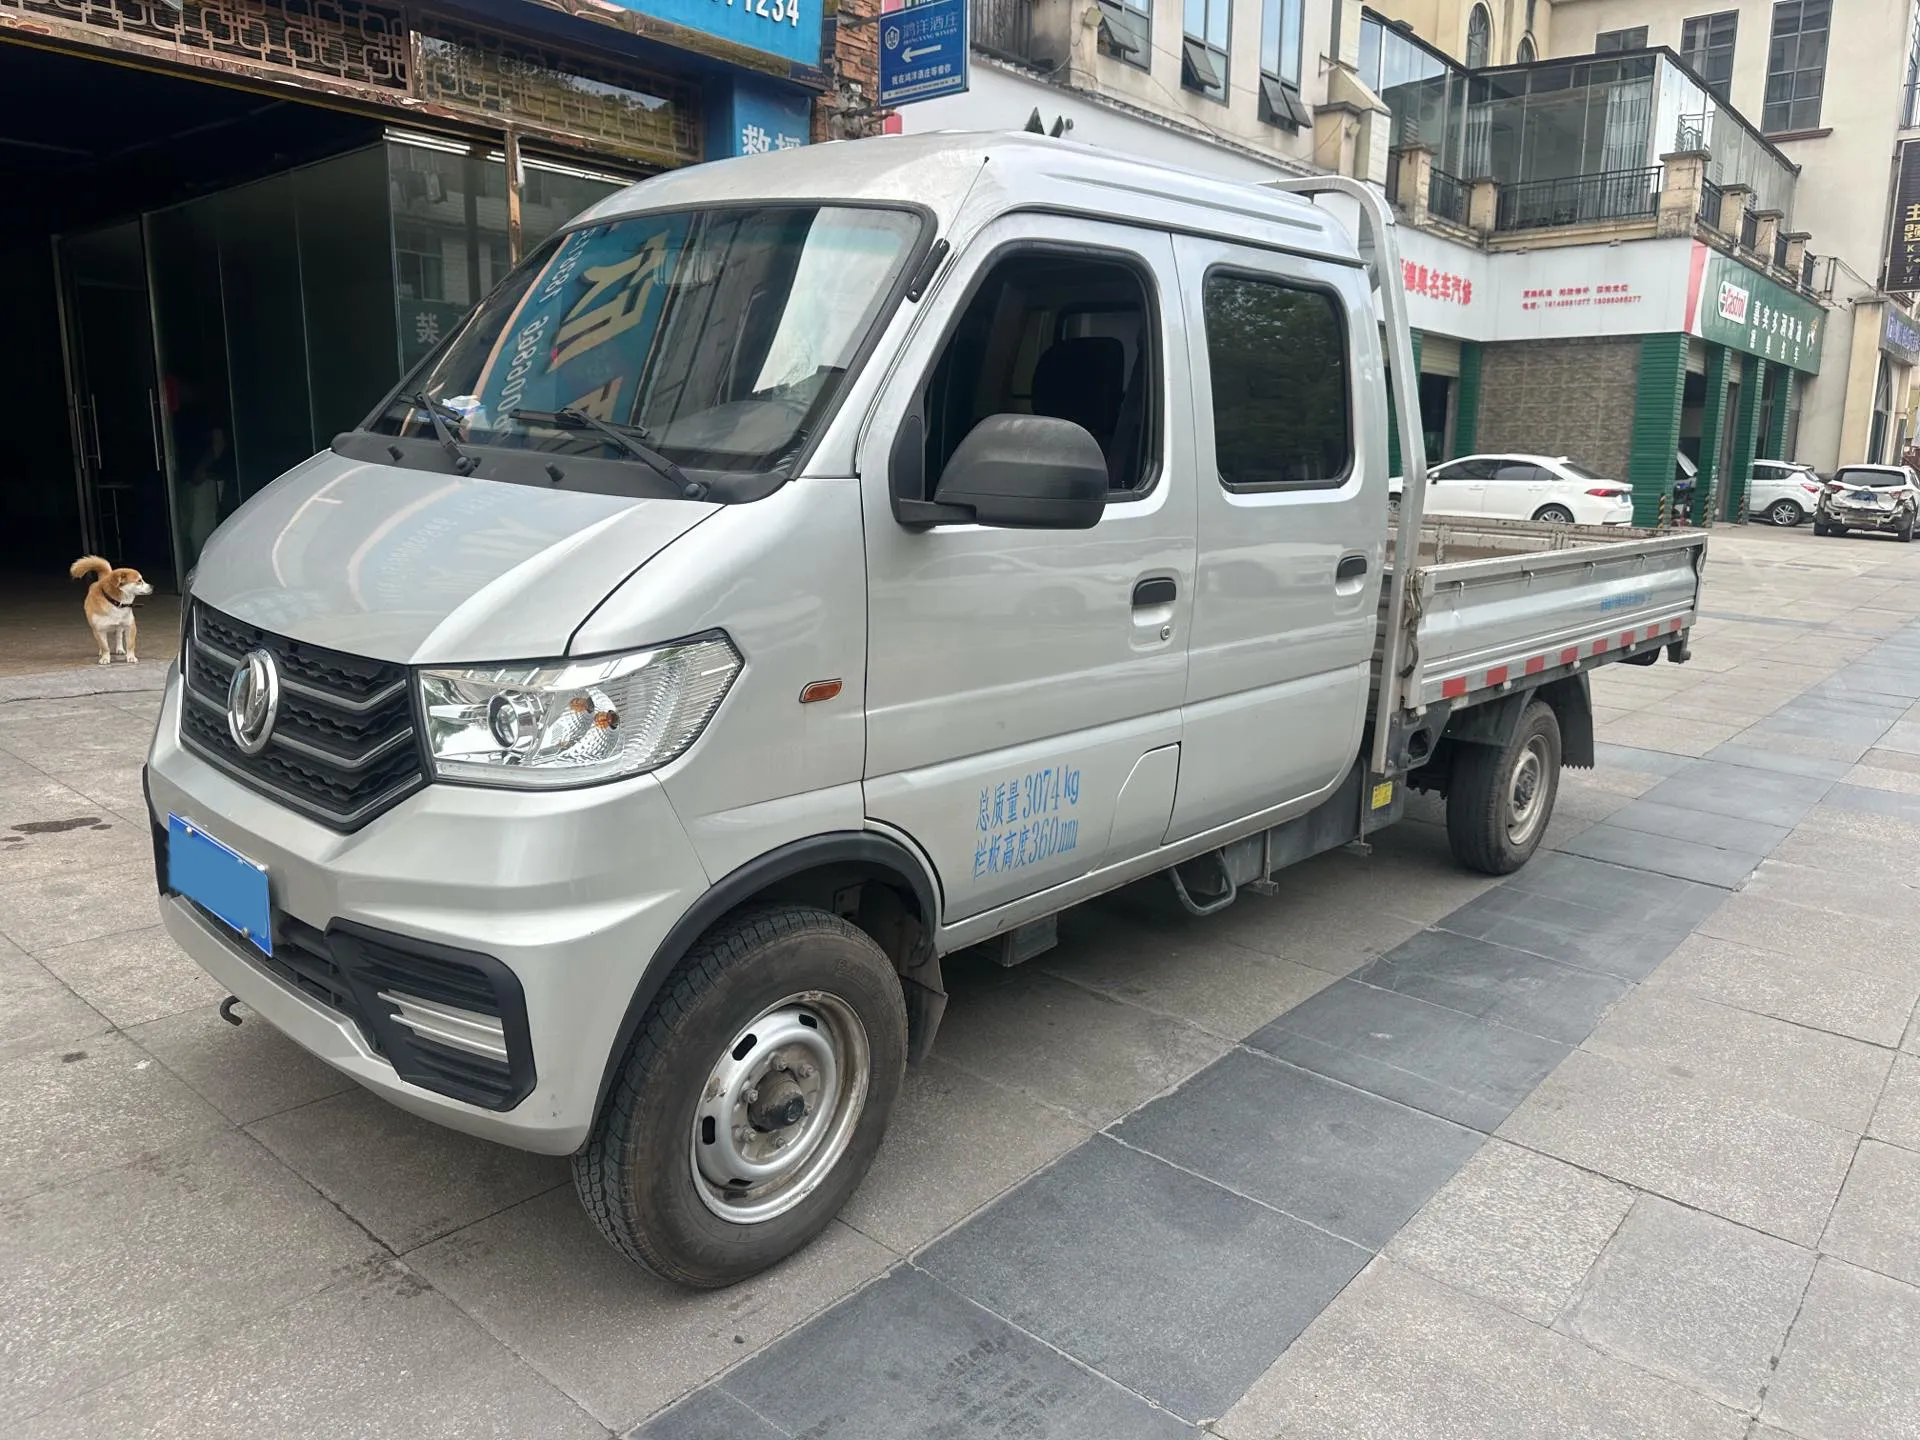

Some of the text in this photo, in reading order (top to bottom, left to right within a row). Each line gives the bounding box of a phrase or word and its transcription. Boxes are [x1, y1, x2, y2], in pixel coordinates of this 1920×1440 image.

[1400, 257, 1472, 305] 德奥名车汽修
